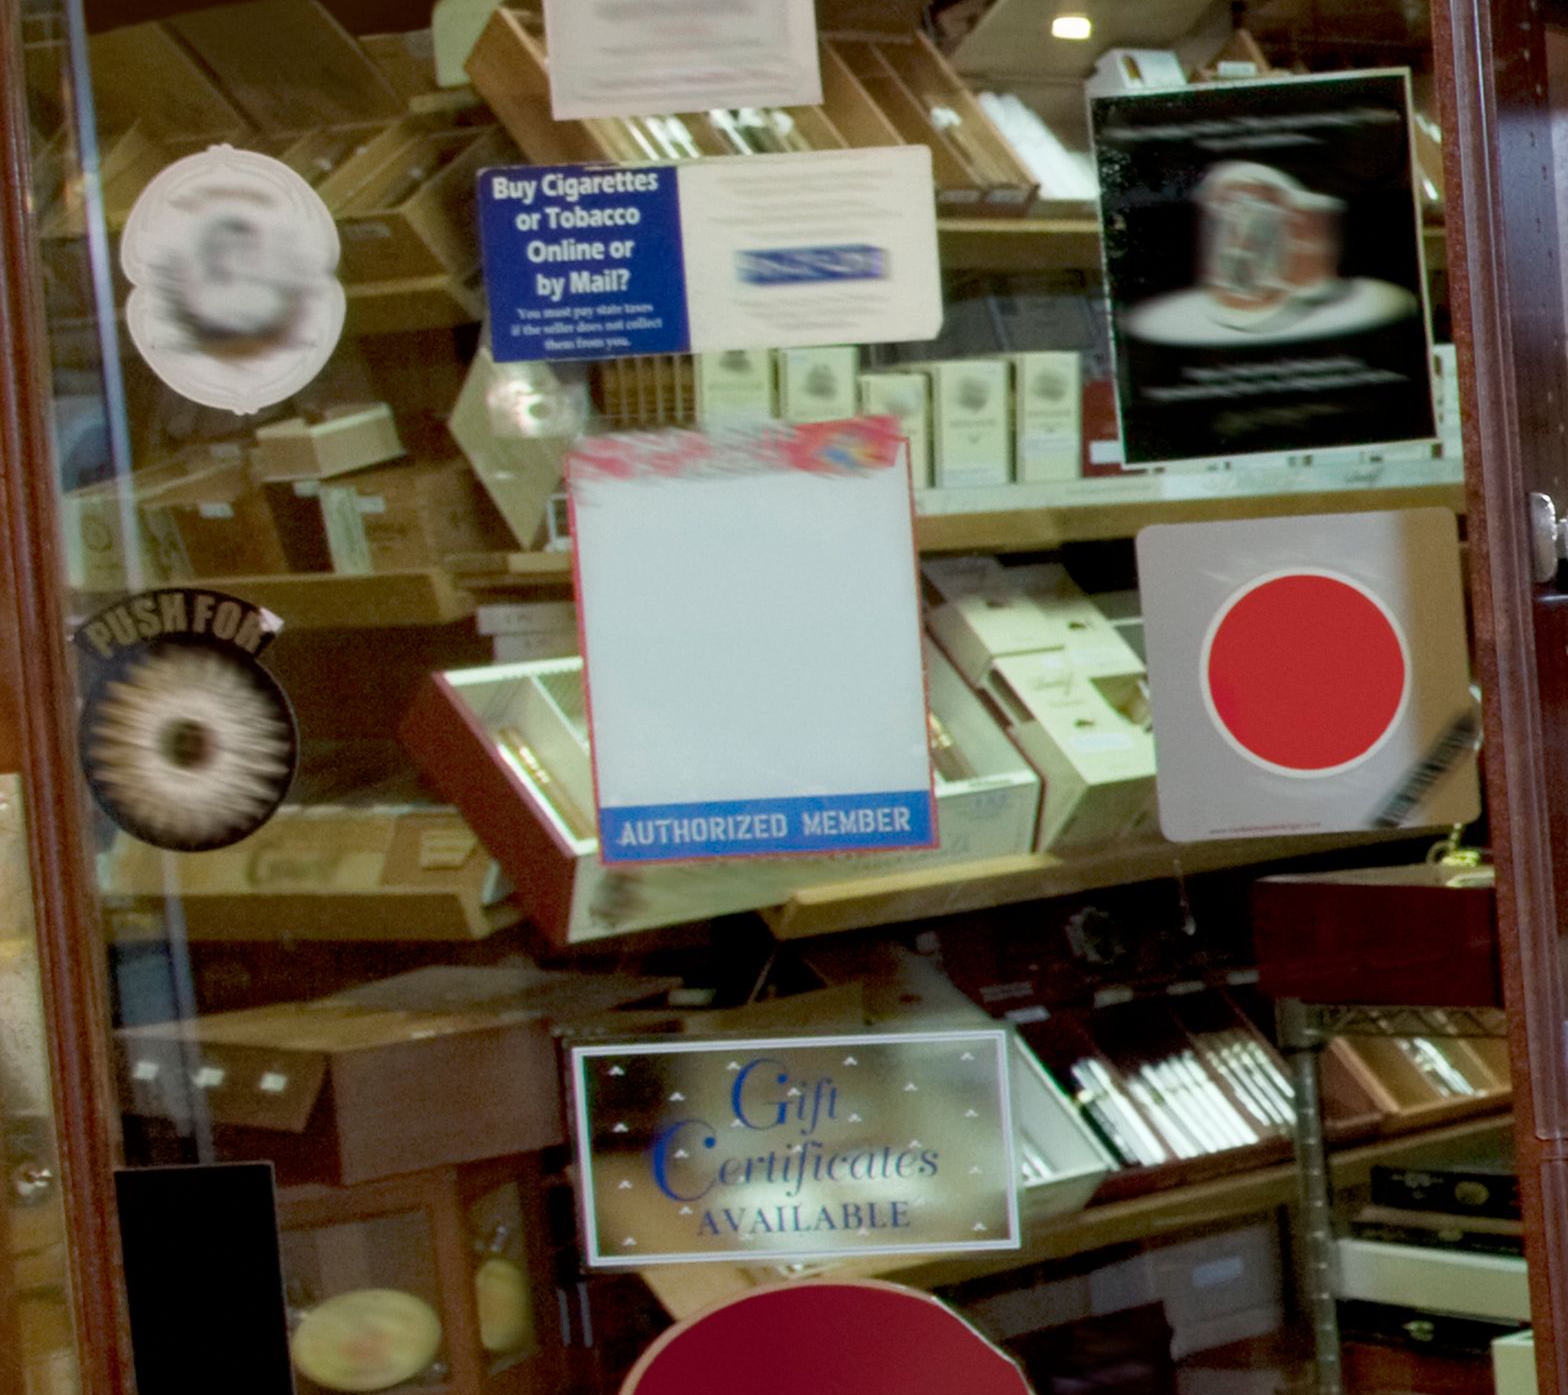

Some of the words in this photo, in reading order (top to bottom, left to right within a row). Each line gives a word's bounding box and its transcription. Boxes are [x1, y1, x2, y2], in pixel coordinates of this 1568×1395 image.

[492, 176, 537, 205] Buy
[542, 171, 658, 202] Cigarettes
[515, 212, 541, 231] or
[545, 206, 641, 229] Tobacco
[526, 239, 605, 263] Online
[609, 240, 635, 259] or
[536, 274, 565, 302] by
[569, 269, 631, 294] Mail?
[511, 324, 521, 336] if
[523, 324, 541, 336] the
[543, 322, 574, 335] seller
[576, 320, 603, 333] does
[605, 319, 624, 331] not
[626, 317, 663, 330] collect
[518, 308, 542, 320] You
[544, 307, 572, 319] must
[574, 307, 594, 320] pay
[545, 339, 575, 351] them
[576, 337, 604, 350] from
[85, 591, 189, 660] PUSH
[617, 812, 788, 846] AUTHORIZED
[802, 806, 911, 836] MEMBER
[730, 1057, 839, 1135] Gift
[652, 1118, 940, 1203] Certificates
[697, 1200, 911, 1236] AVAILABLE
